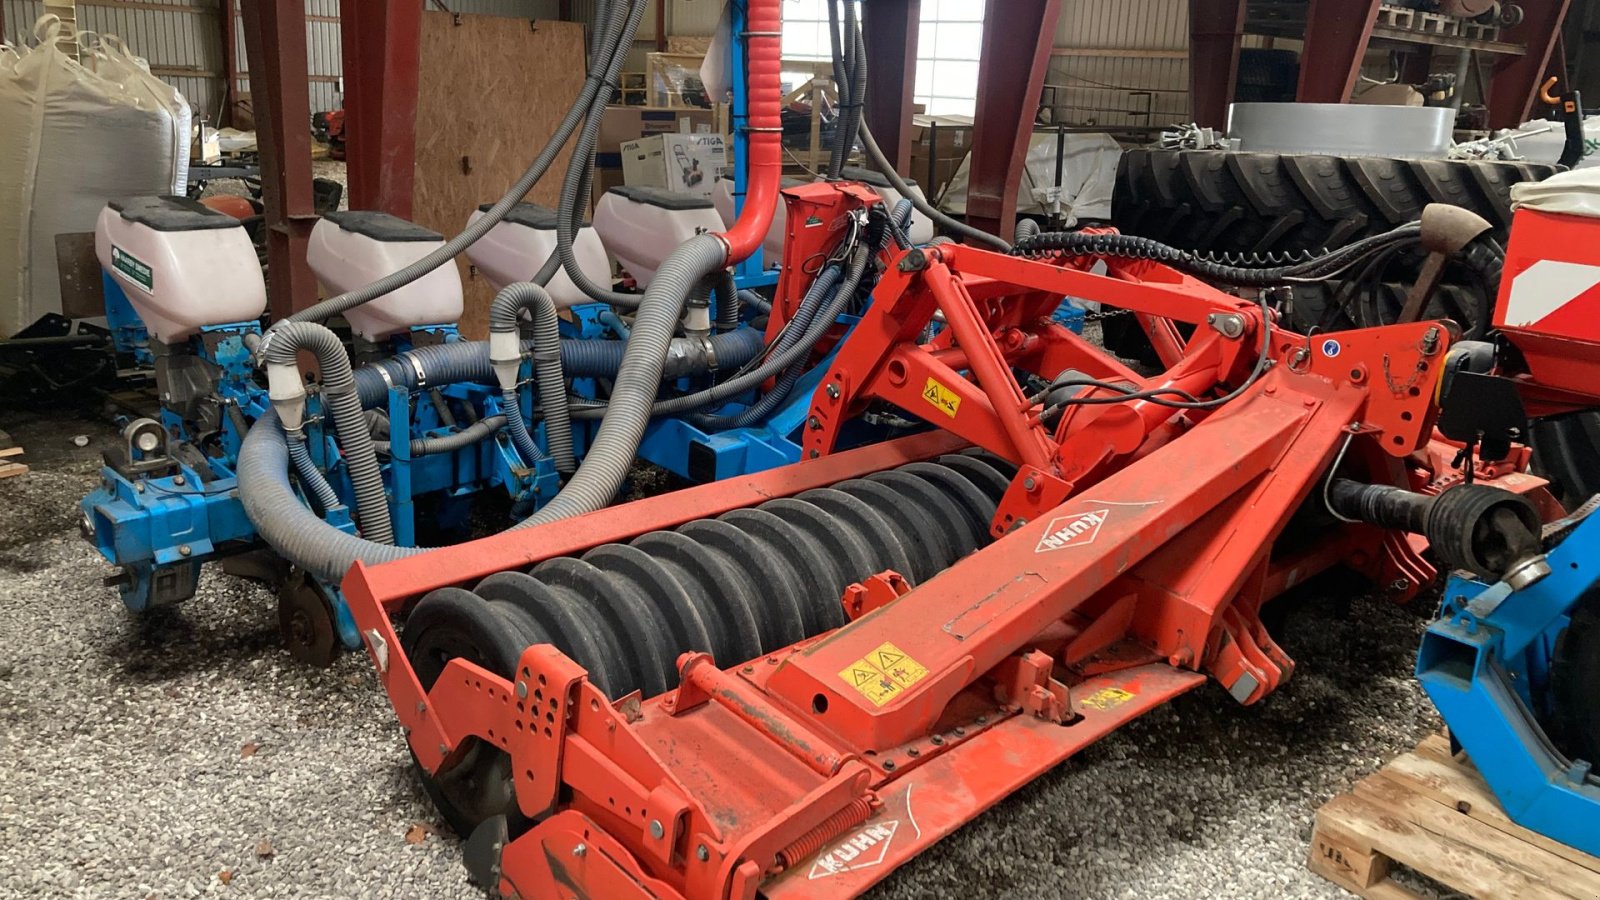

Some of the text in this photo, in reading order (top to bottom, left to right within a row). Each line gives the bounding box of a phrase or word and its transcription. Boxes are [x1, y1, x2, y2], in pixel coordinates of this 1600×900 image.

[695, 136, 722, 145] STIGA
[1042, 513, 1103, 549] KUHN
[817, 824, 892, 873] KUHN
